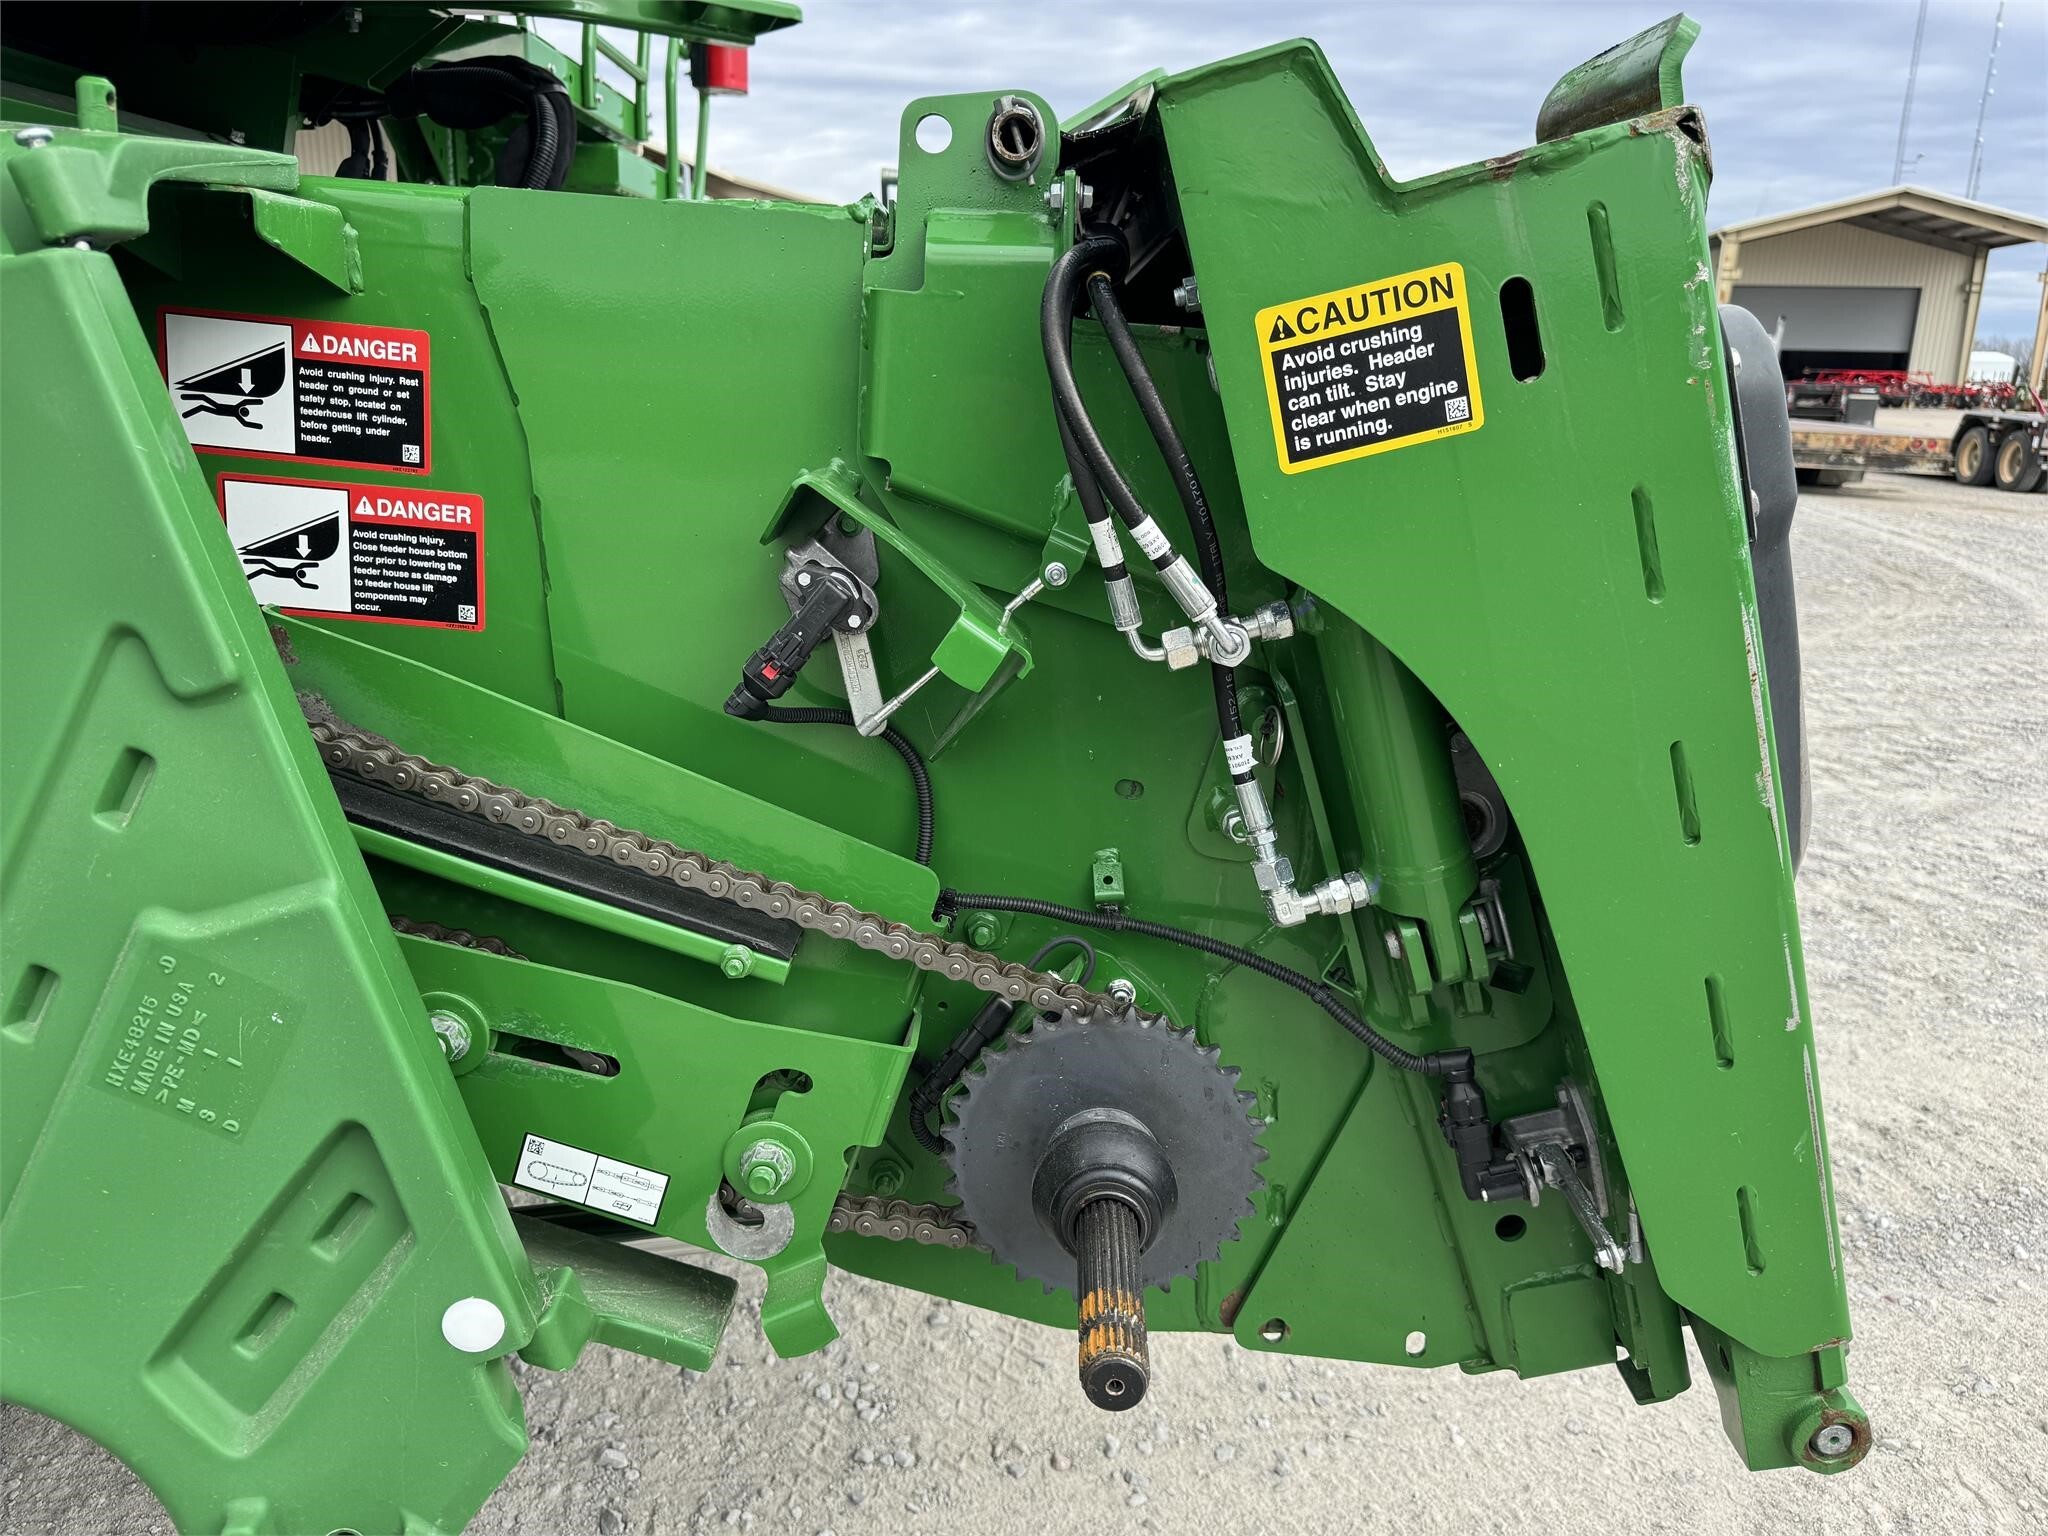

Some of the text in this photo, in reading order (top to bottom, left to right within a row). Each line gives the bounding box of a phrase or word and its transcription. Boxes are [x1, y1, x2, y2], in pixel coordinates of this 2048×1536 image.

[1297, 272, 1454, 335] CAUTION
[323, 335, 417, 362] DANGER
[1282, 325, 1423, 371] Avoid crushing
[1284, 343, 1435, 391] injuries. Header
[299, 367, 419, 386] Avoid crushing injury. Rest
[300, 380, 328, 390] header
[349, 387, 378, 396] ground
[397, 391, 409, 399] set
[1288, 371, 1407, 411] can tilt. Stay
[300, 395, 325, 405] safety
[330, 398, 351, 407] stop,
[355, 399, 386, 409] located
[1291, 380, 1458, 431] clear when engine
[300, 407, 407, 426] feederhouse lift cylinder,
[301, 420, 390, 436] before getting under
[1294, 418, 1392, 452] is running.
[301, 433, 331, 443] header.
[377, 499, 471, 524] DANGER
[353, 530, 445, 546] Avoid crushing injury.
[353, 542, 467, 559] Close feeder house bottom
[354, 554, 461, 571] door prior to lowering the
[354, 567, 380, 575] feeder
[383, 569, 409, 578] house
[424, 571, 457, 583] damage
[365, 580, 392, 588] feeder
[394, 582, 420, 591] house
[422, 584, 433, 592] lift
[355, 592, 427, 605] components may
[208, 972, 226, 986] 2
[105, 955, 177, 1087] HXE48215 JD
[130, 982, 195, 1094] MADE IN USA
[176, 1098, 196, 1113] M
[199, 1109, 216, 1121] S
[222, 1119, 240, 1132] D
